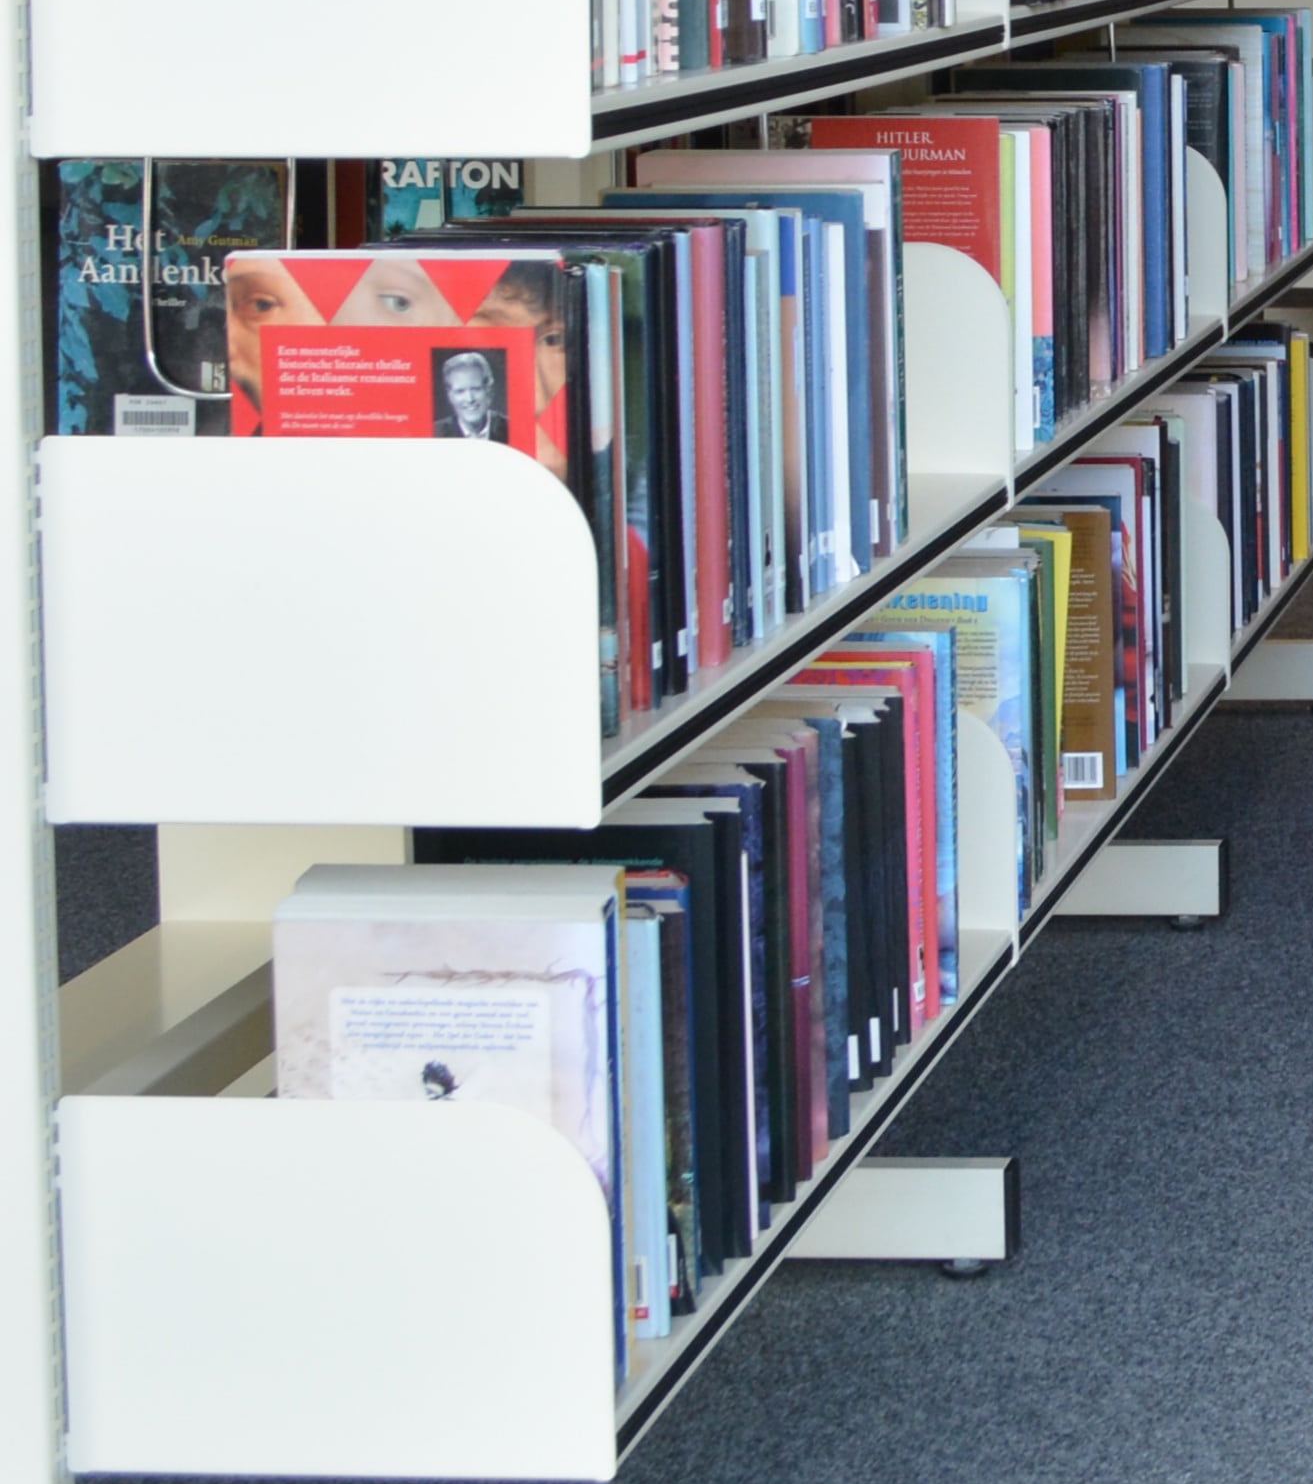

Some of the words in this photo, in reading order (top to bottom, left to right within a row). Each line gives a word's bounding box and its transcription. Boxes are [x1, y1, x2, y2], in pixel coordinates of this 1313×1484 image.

[875, 131, 935, 145] HITLER
[901, 147, 967, 162] URMAN
[382, 158, 521, 191] RAFTON
